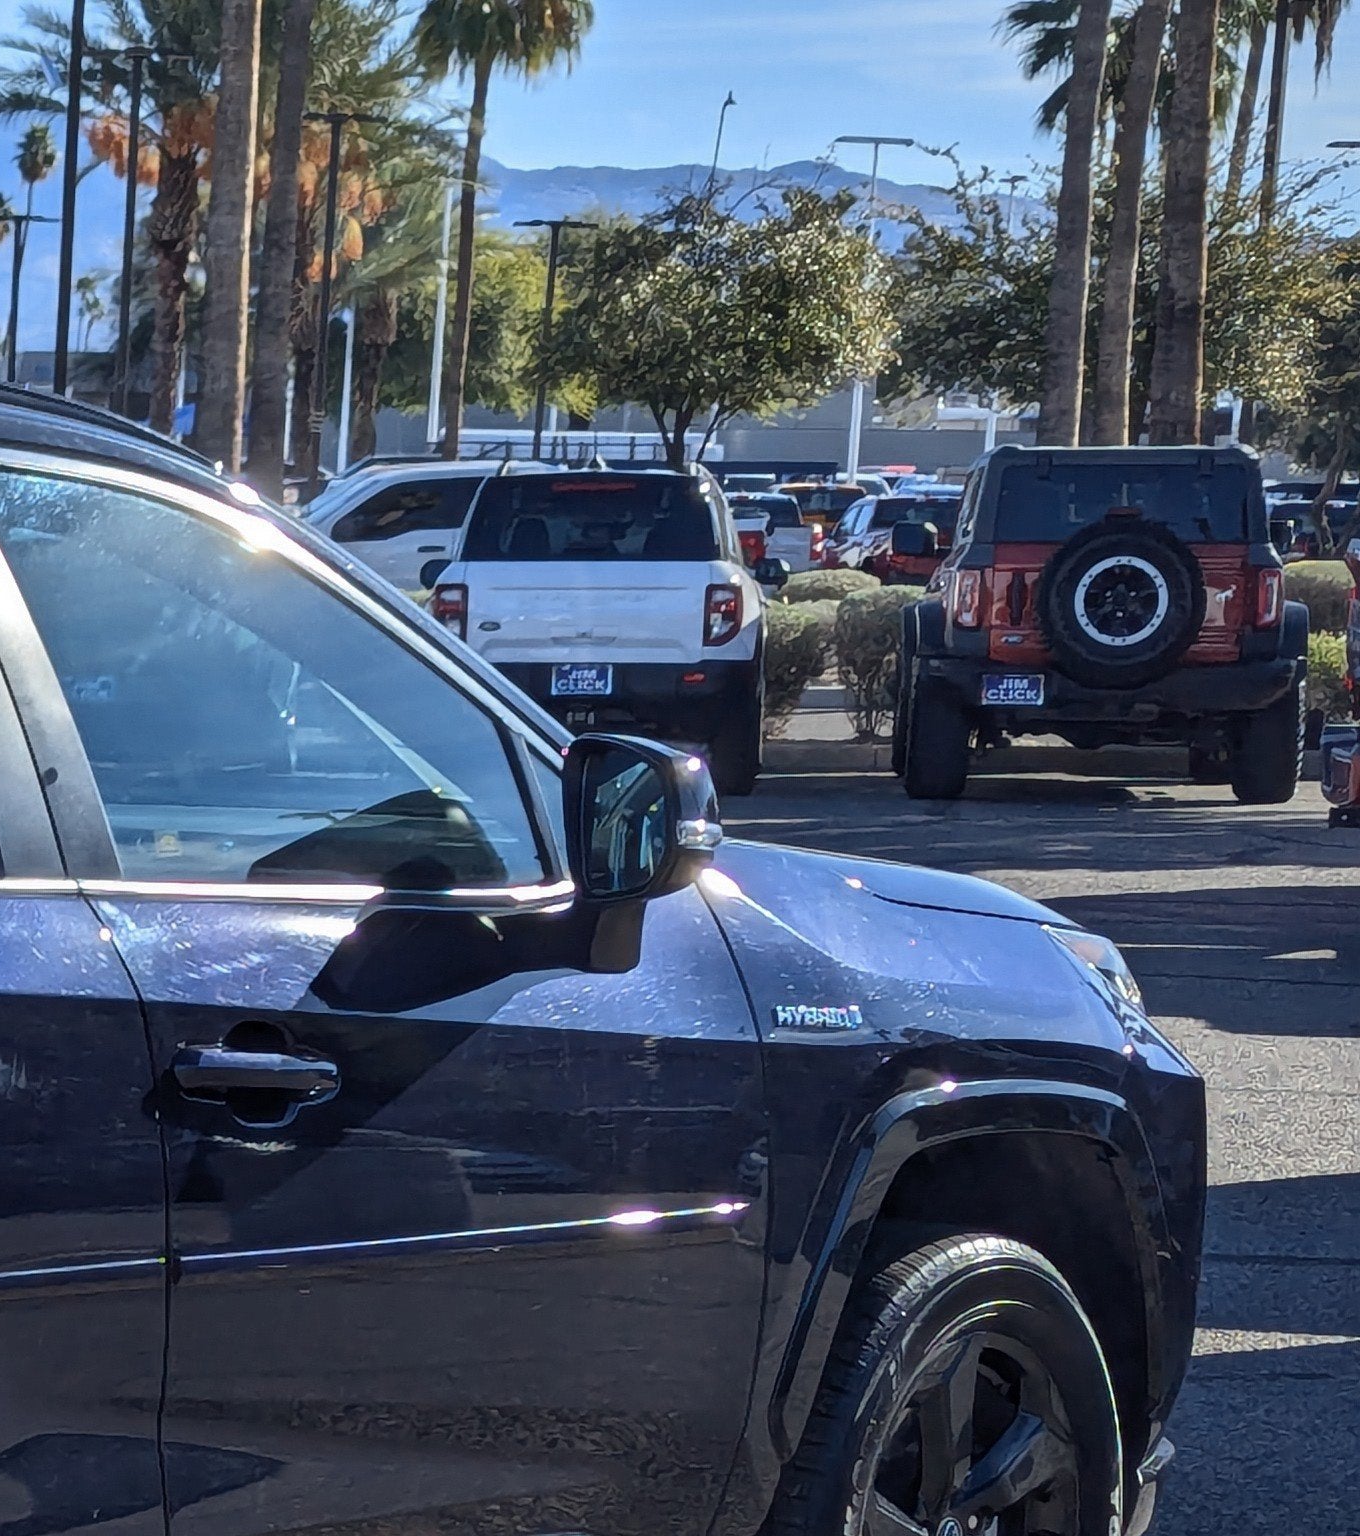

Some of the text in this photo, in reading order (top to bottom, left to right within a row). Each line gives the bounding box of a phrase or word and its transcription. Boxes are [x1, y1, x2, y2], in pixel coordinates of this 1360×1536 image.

[998, 678, 1029, 689] JIM
[986, 689, 1038, 699] CLICK
[776, 1005, 851, 1027] HYBRID
